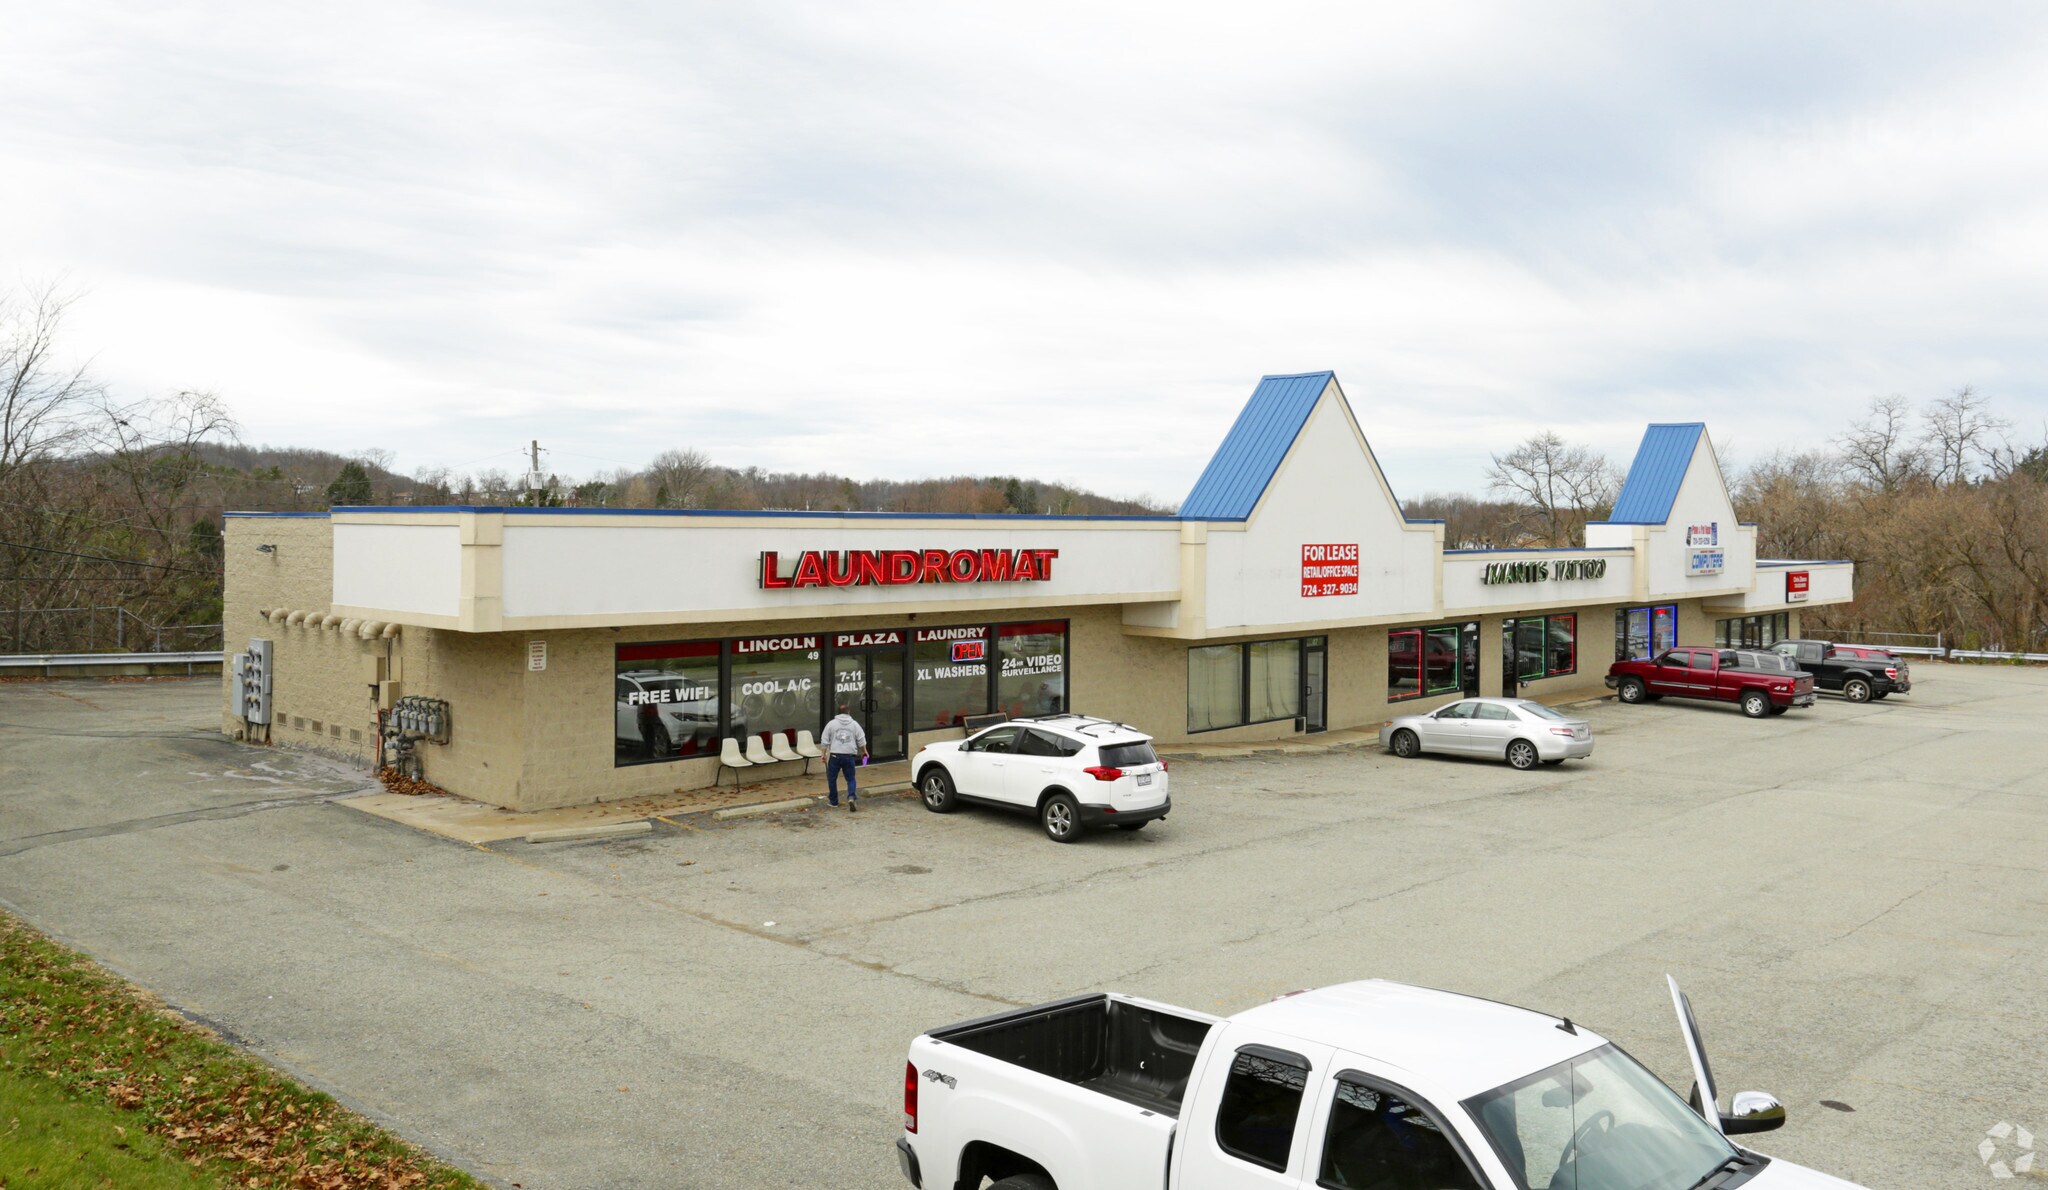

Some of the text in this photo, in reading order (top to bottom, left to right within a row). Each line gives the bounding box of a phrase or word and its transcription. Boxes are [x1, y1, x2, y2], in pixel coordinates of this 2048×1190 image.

[1304, 545, 1357, 561] FOR LEASE
[760, 549, 1059, 589] LAUNDROMAT
[1341, 565, 1358, 577] SPACE
[738, 627, 986, 653] LINCOLN PLAZA LAUNDRY
[807, 652, 819, 660] 49
[953, 642, 984, 660] OPEN
[1026, 654, 1062, 667] VIDEO
[839, 670, 862, 682] 7-11
[917, 664, 987, 681] XL WASHERS
[1001, 665, 1062, 677] SURVEILLANCE
[742, 678, 812, 696] COOL A/C
[836, 681, 865, 693] DAILY
[628, 686, 710, 706] FREE WIFI
